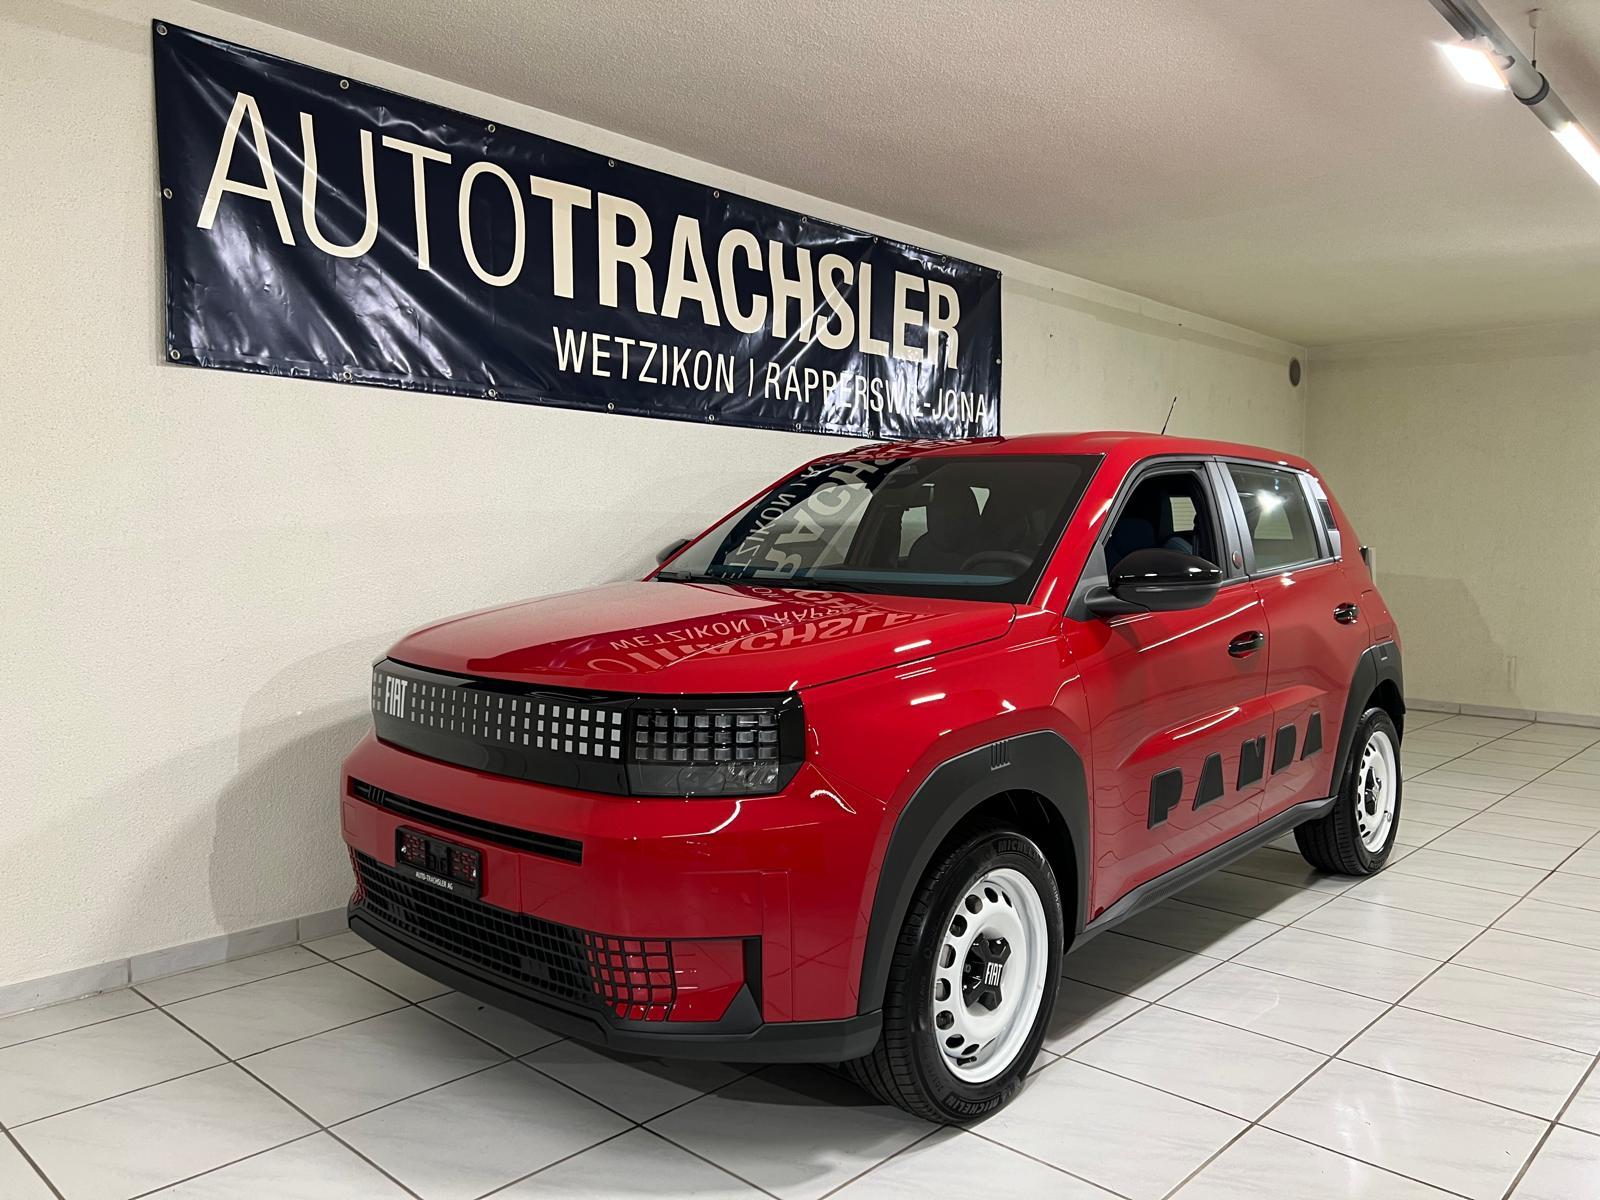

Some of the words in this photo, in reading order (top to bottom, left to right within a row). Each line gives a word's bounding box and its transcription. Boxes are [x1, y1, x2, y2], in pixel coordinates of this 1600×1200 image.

[552, 326, 734, 393] WETZIKON
[764, 362, 987, 423] RAPPERSWIL-JONA
[384, 676, 408, 718] FIAT
[1148, 711, 1322, 829] PANDA
[985, 962, 1003, 987] FIAT
[945, 1095, 1000, 1115] MICHELIN
